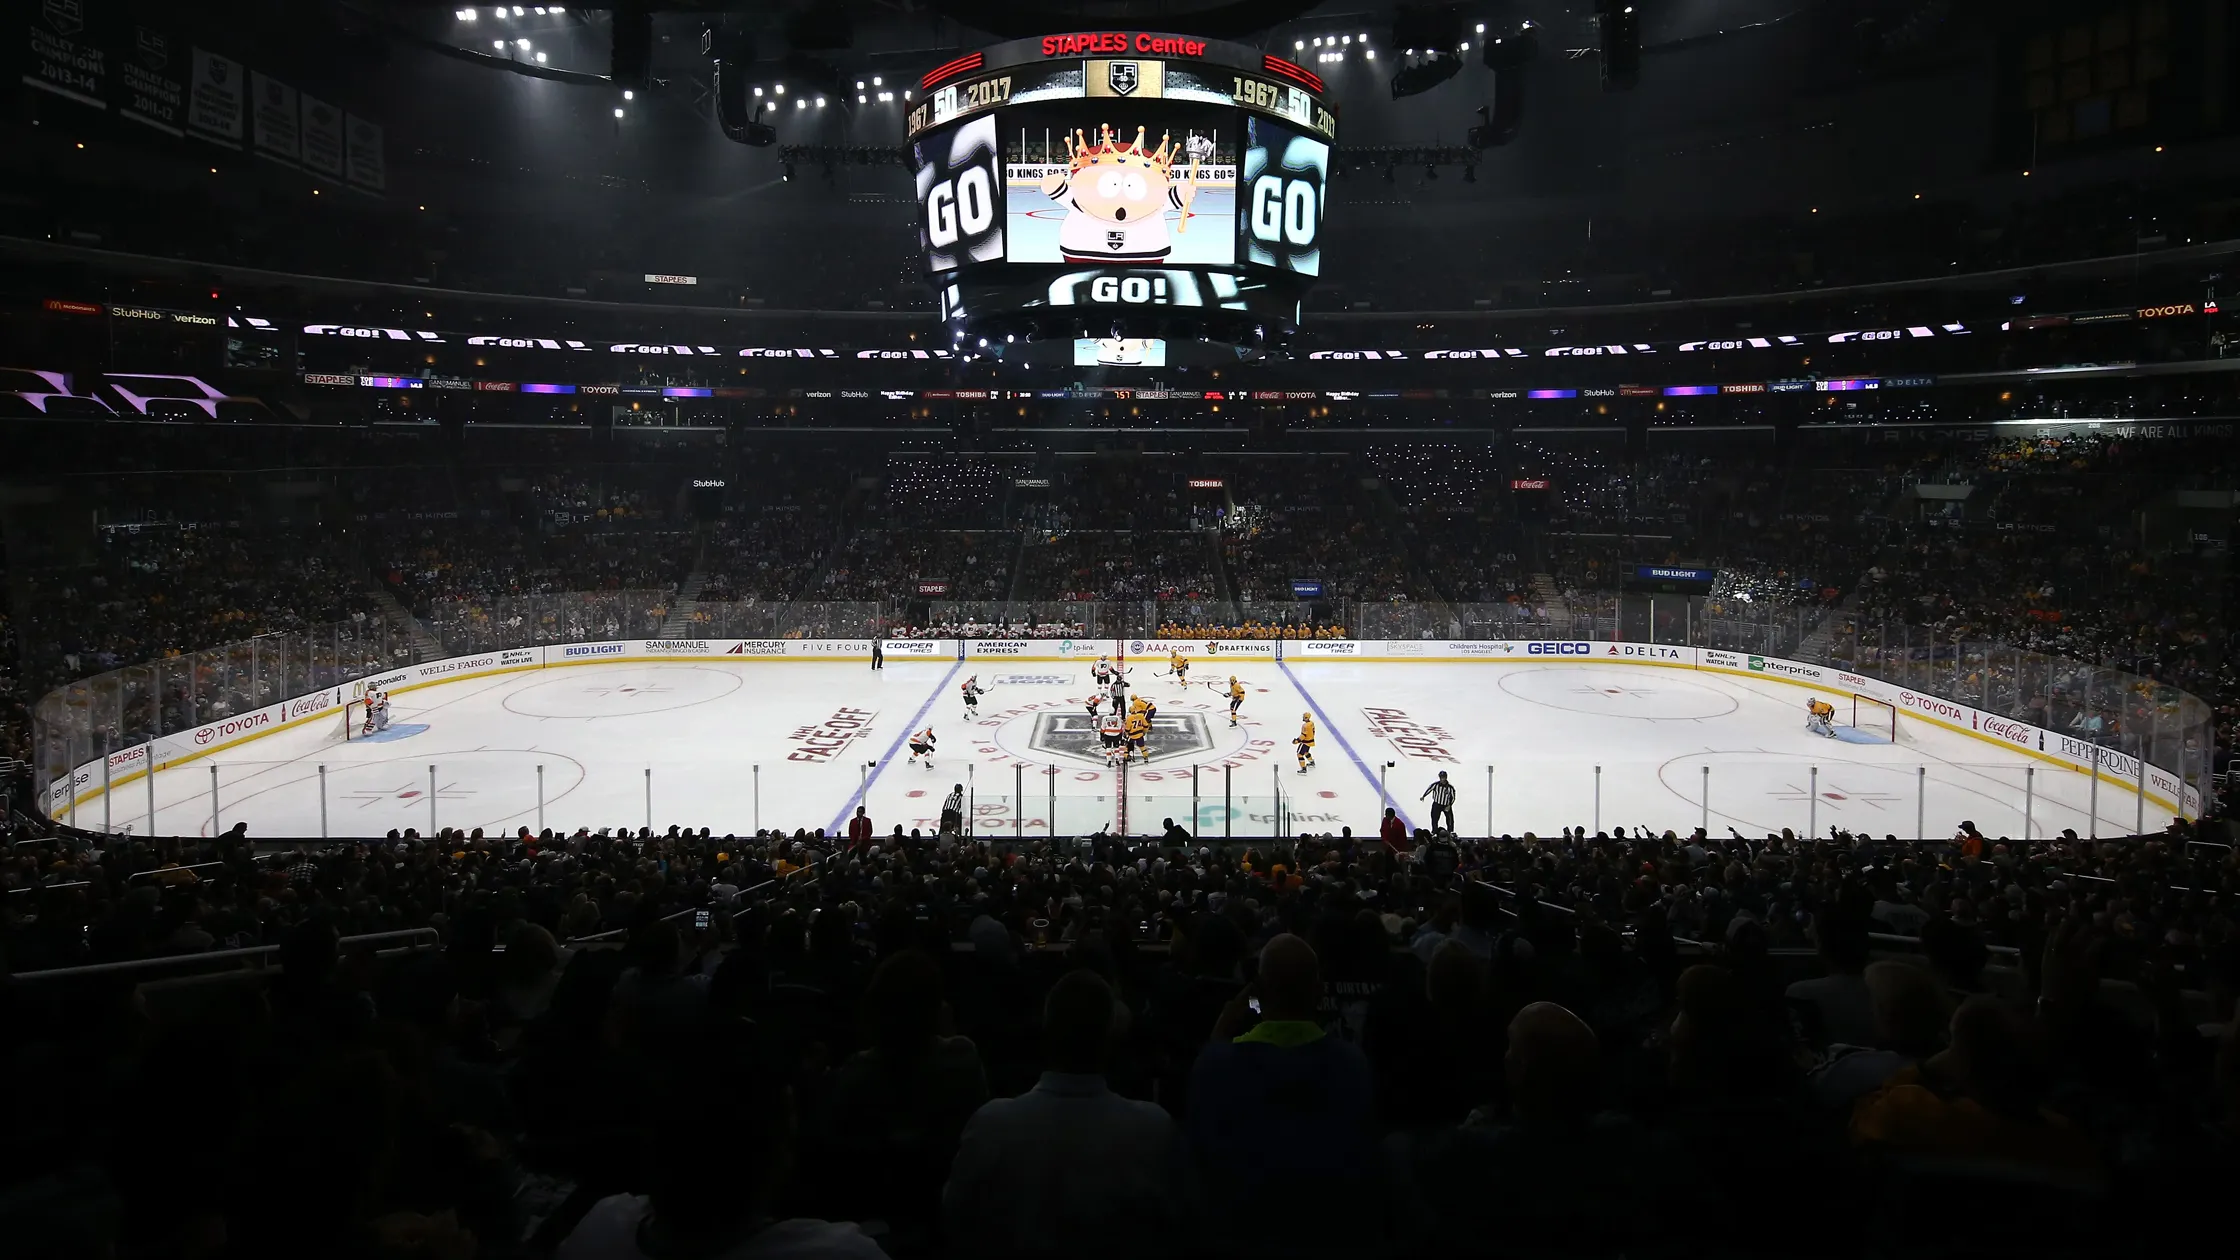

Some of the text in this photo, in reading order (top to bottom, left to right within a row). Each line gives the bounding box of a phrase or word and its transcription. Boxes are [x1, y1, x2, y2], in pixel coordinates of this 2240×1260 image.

[30, 26, 74, 51] STANLEY
[1042, 33, 1206, 56] STAPLES Center
[30, 39, 104, 75] CHAMPIONS
[40, 60, 96, 92] 2013-14
[123, 62, 162, 84] STANLEY
[1114, 65, 1134, 76] LA
[124, 74, 182, 106] CHAMPIONS
[133, 94, 174, 120] 2011-12
[908, 76, 1012, 136] 1967 50 2017
[1233, 76, 1336, 139] 1967 50 2017
[1017, 168, 1043, 178] KINGS
[1170, 170, 1226, 180] GO KNGS GO
[928, 165, 994, 248] GO
[1251, 174, 1316, 245] GO
[1108, 231, 1124, 240] LA
[655, 276, 688, 284] STAPLES
[1091, 276, 1167, 304] GO!
[63, 304, 96, 312] McDonald's
[2137, 304, 2194, 318] TOYOTA
[112, 308, 161, 320] StubHub
[174, 314, 216, 324] verizon
[340, 328, 380, 338] GO!
[1862, 330, 1901, 340] GO!
[499, 338, 534, 348] GO!
[1708, 340, 1742, 350] GO!
[638, 346, 669, 354] GO!
[764, 350, 792, 358] GO!
[881, 351, 908, 360] GO!
[1449, 350, 1477, 358] GO!
[1572, 347, 1602, 355] GO!
[1333, 352, 1360, 360] GO!
[306, 374, 352, 384] STAPLES
[1897, 378, 1932, 386] DELTA
[581, 386, 618, 394] TOYOTA
[1136, 391, 1168, 399] STAPLES
[2116, 424, 2233, 438] WE ARE ALL KINGS
[693, 480, 725, 488] StubHub
[1189, 480, 1223, 488] TOSHIBA
[1652, 569, 1696, 578] BUD LIGHT
[566, 644, 623, 656] BUD LIGHT
[1074, 644, 1094, 652] tp-link
[1146, 644, 1194, 652] AAA.com
[1478, 644, 1504, 652] Hospital
[1528, 642, 1590, 655] GEICO
[1625, 646, 1679, 658] DELTA
[500, 656, 532, 666] WATCH LIVE
[420, 658, 494, 676] WELLS FARGO
[1752, 659, 1820, 678] enterprise
[376, 674, 406, 686] cDonald's
[1838, 672, 1866, 686] STAPLES
[1916, 696, 1962, 720] TOYOTA
[217, 712, 269, 737] TOYOTA
[1132, 720, 1143, 729] 74
[1983, 716, 2032, 744] Coca-Cola
[787, 707, 872, 764] FACE-OFF
[788, 725, 818, 740] NHL
[1364, 707, 1461, 764] FACE-OFF
[109, 748, 144, 767] STAPLES
